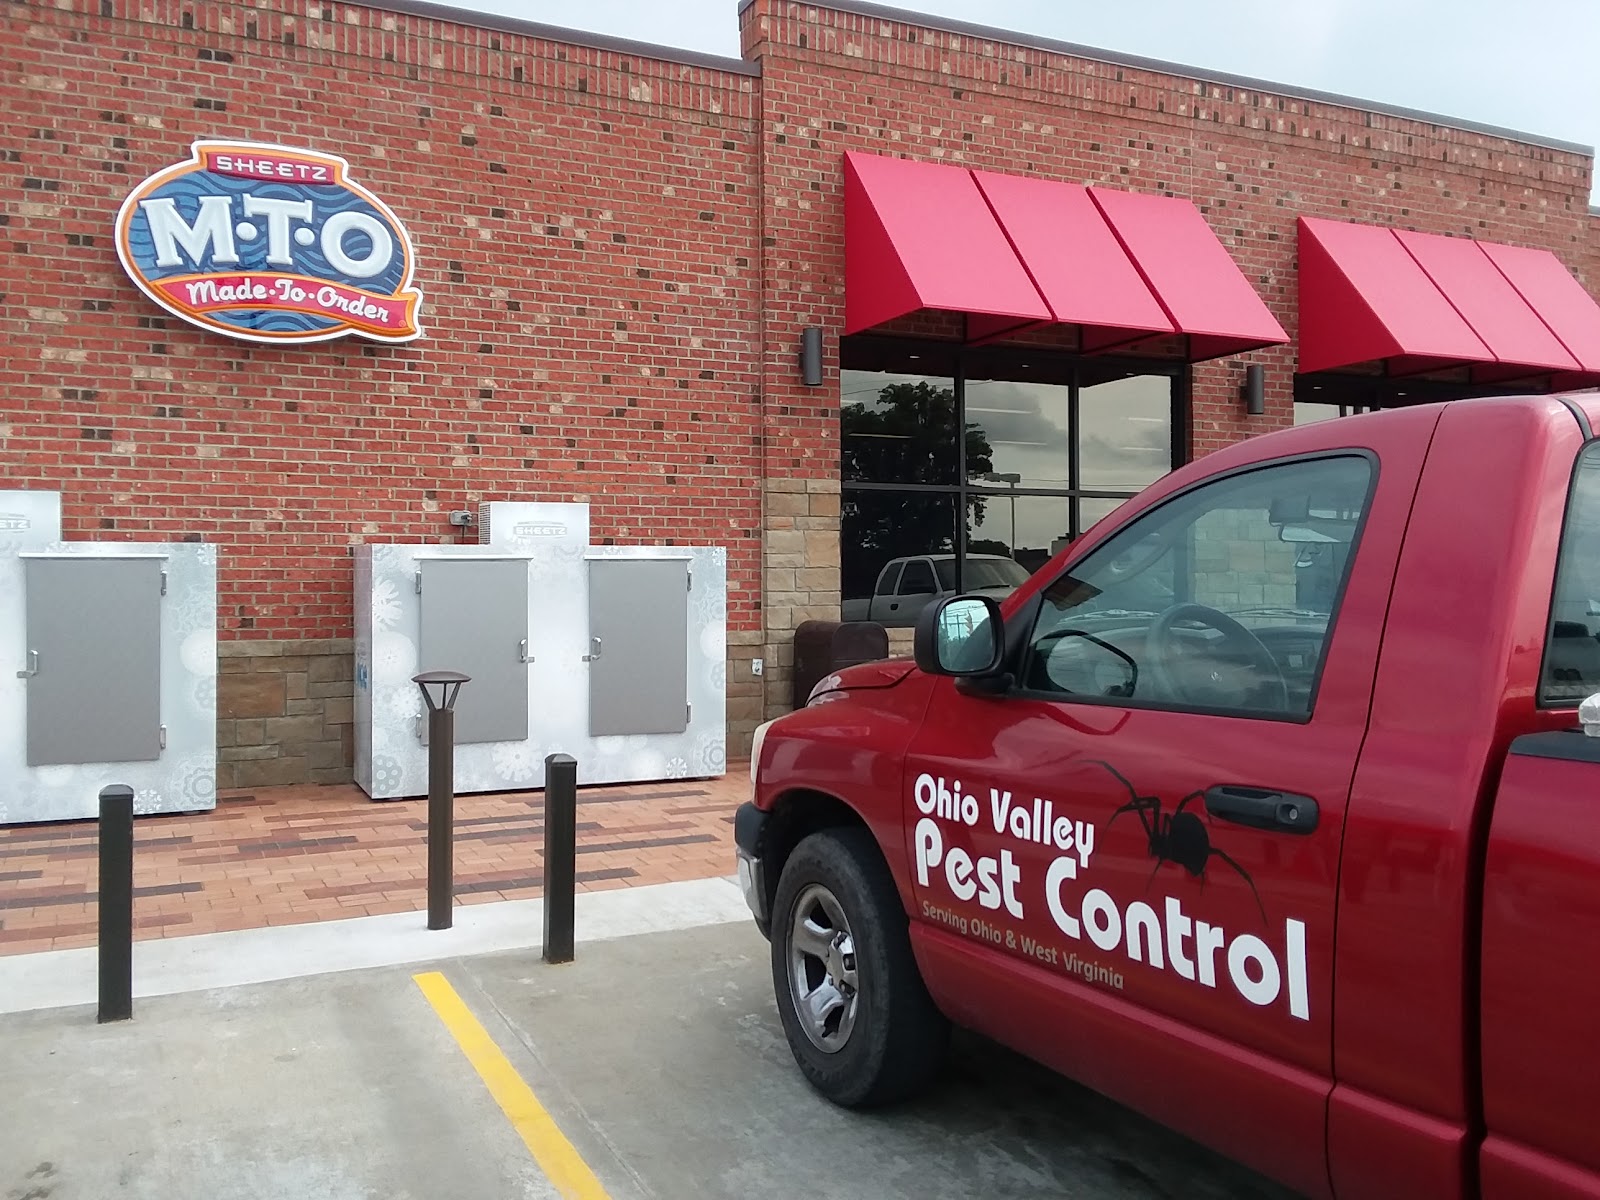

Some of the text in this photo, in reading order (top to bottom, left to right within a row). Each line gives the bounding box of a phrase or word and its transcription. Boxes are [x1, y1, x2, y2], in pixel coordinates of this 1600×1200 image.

[216, 155, 328, 180] SHEETZ
[516, 526, 566, 535] SHEETZ
[914, 773, 1094, 868] Ohio Valley
[914, 818, 1310, 1021] Pest Control
[922, 900, 1124, 990] Serving Ohio & West Virginia
